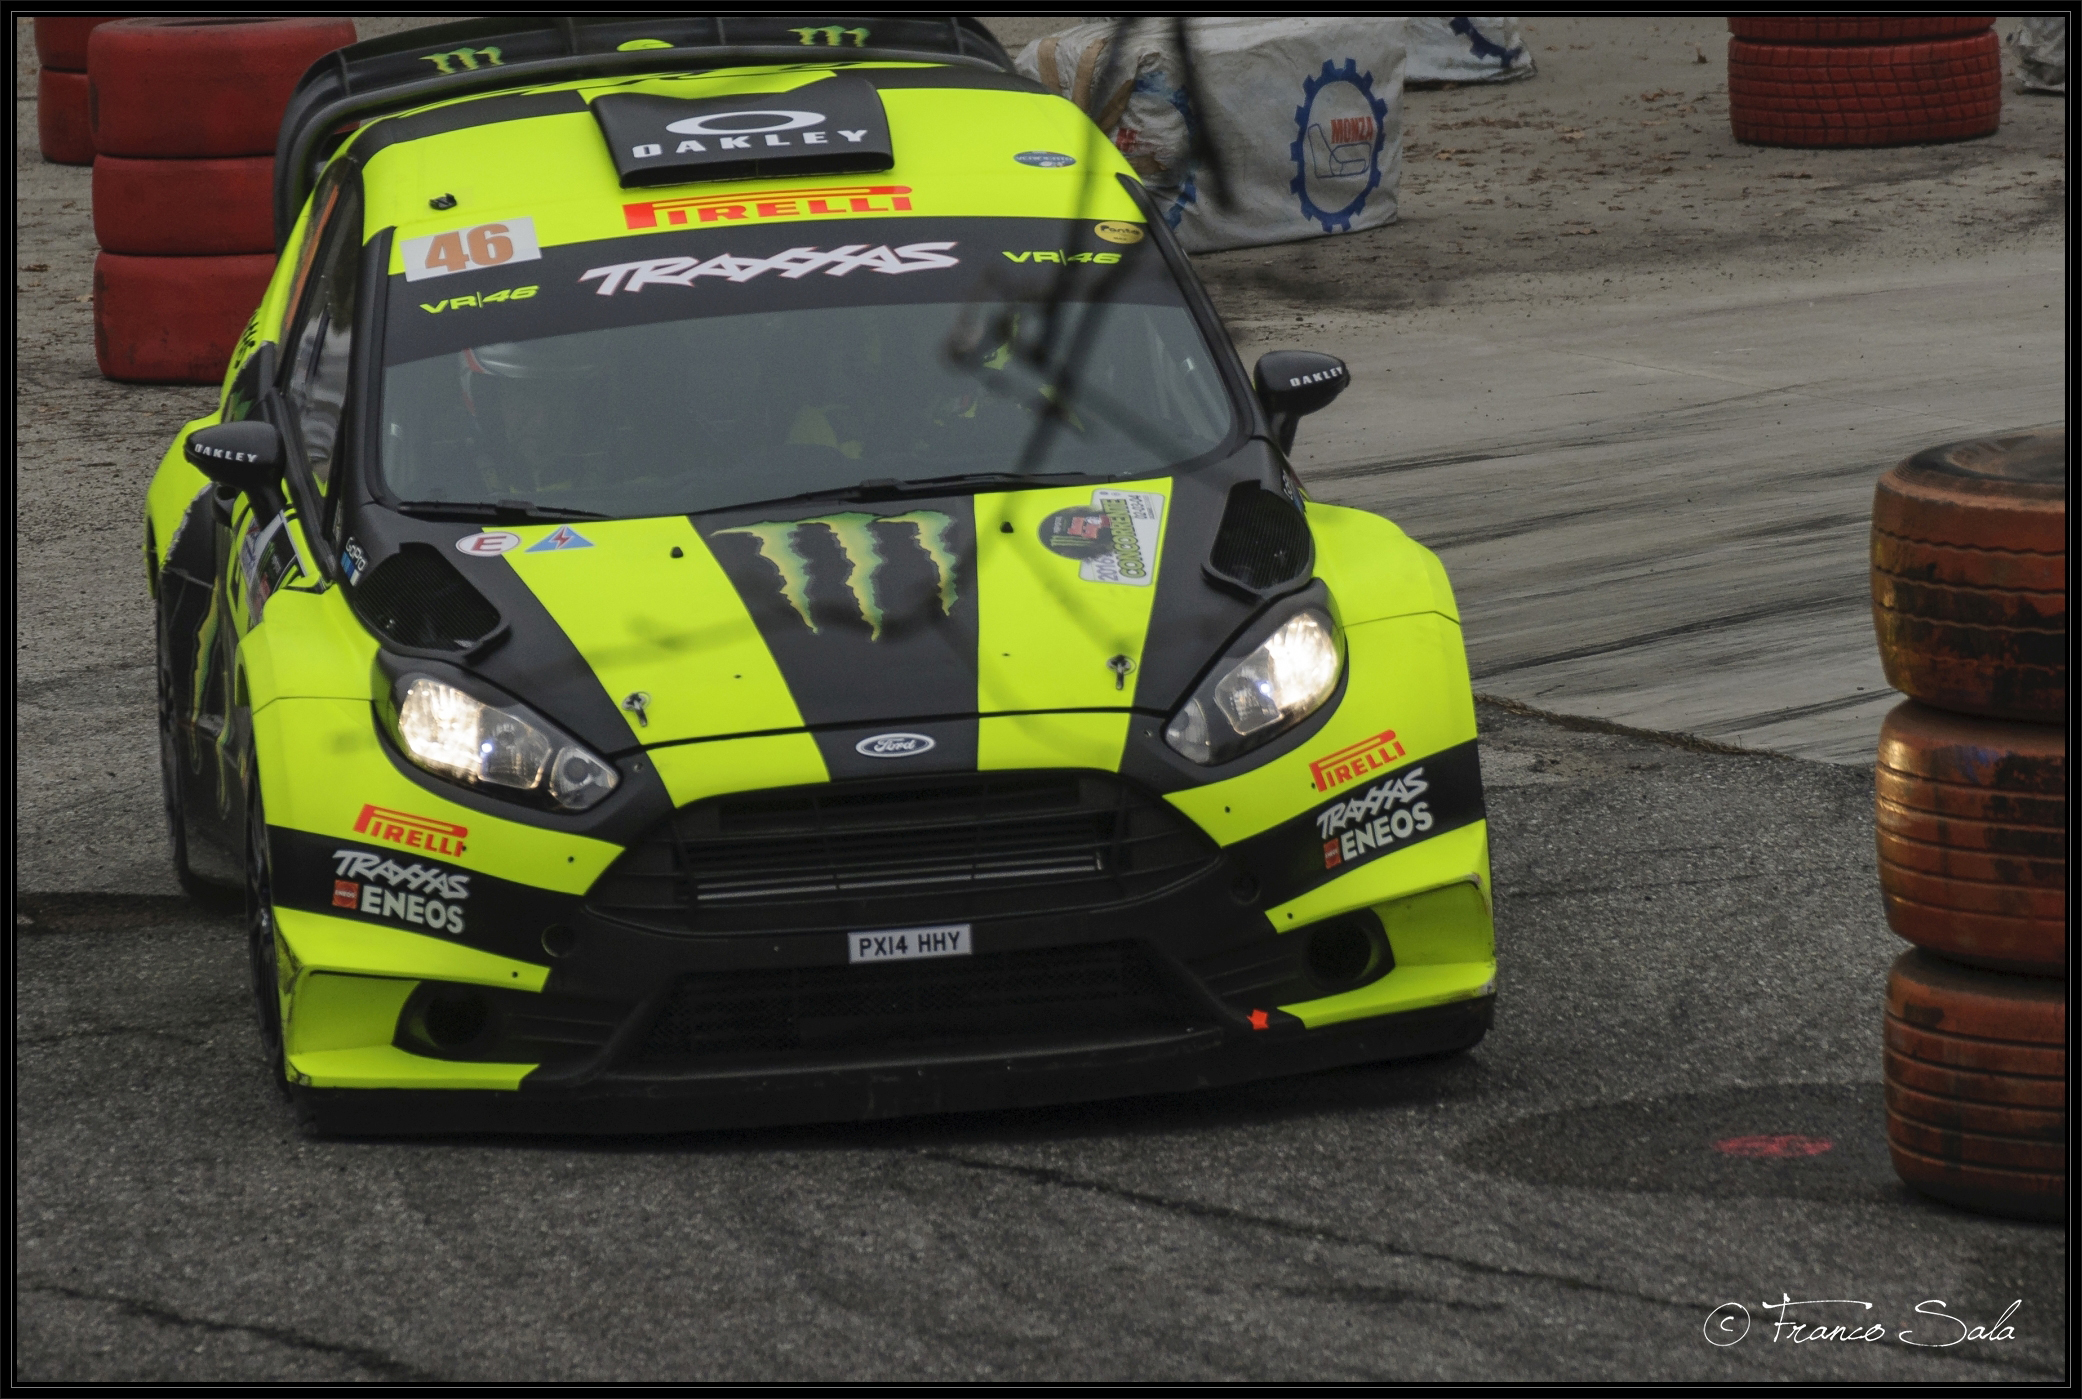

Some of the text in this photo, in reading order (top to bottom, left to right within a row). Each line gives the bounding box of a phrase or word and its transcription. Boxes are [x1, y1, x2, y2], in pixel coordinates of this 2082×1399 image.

[632, 129, 868, 158] OAKLEY
[1331, 116, 1373, 144] MONZA
[622, 185, 912, 230] PIRELLI
[425, 223, 513, 272] 46
[579, 242, 959, 296] TRAXXAS
[1289, 366, 1343, 387] OAKLEY
[194, 443, 258, 463] OAKLEY
[345, 536, 367, 572] GoPro
[470, 536, 506, 551] E
[1100, 499, 1147, 578] CONCORRENTE
[874, 738, 916, 752] Ford
[1309, 730, 1406, 792] PIRELLI
[1317, 767, 1428, 839] TRAXXAS
[353, 804, 468, 857] PIRELLI
[1341, 802, 1433, 861] ENEOS
[332, 850, 470, 899] TRAXXAS
[361, 884, 465, 934] ENEOS
[918, 931, 960, 953] HHY
